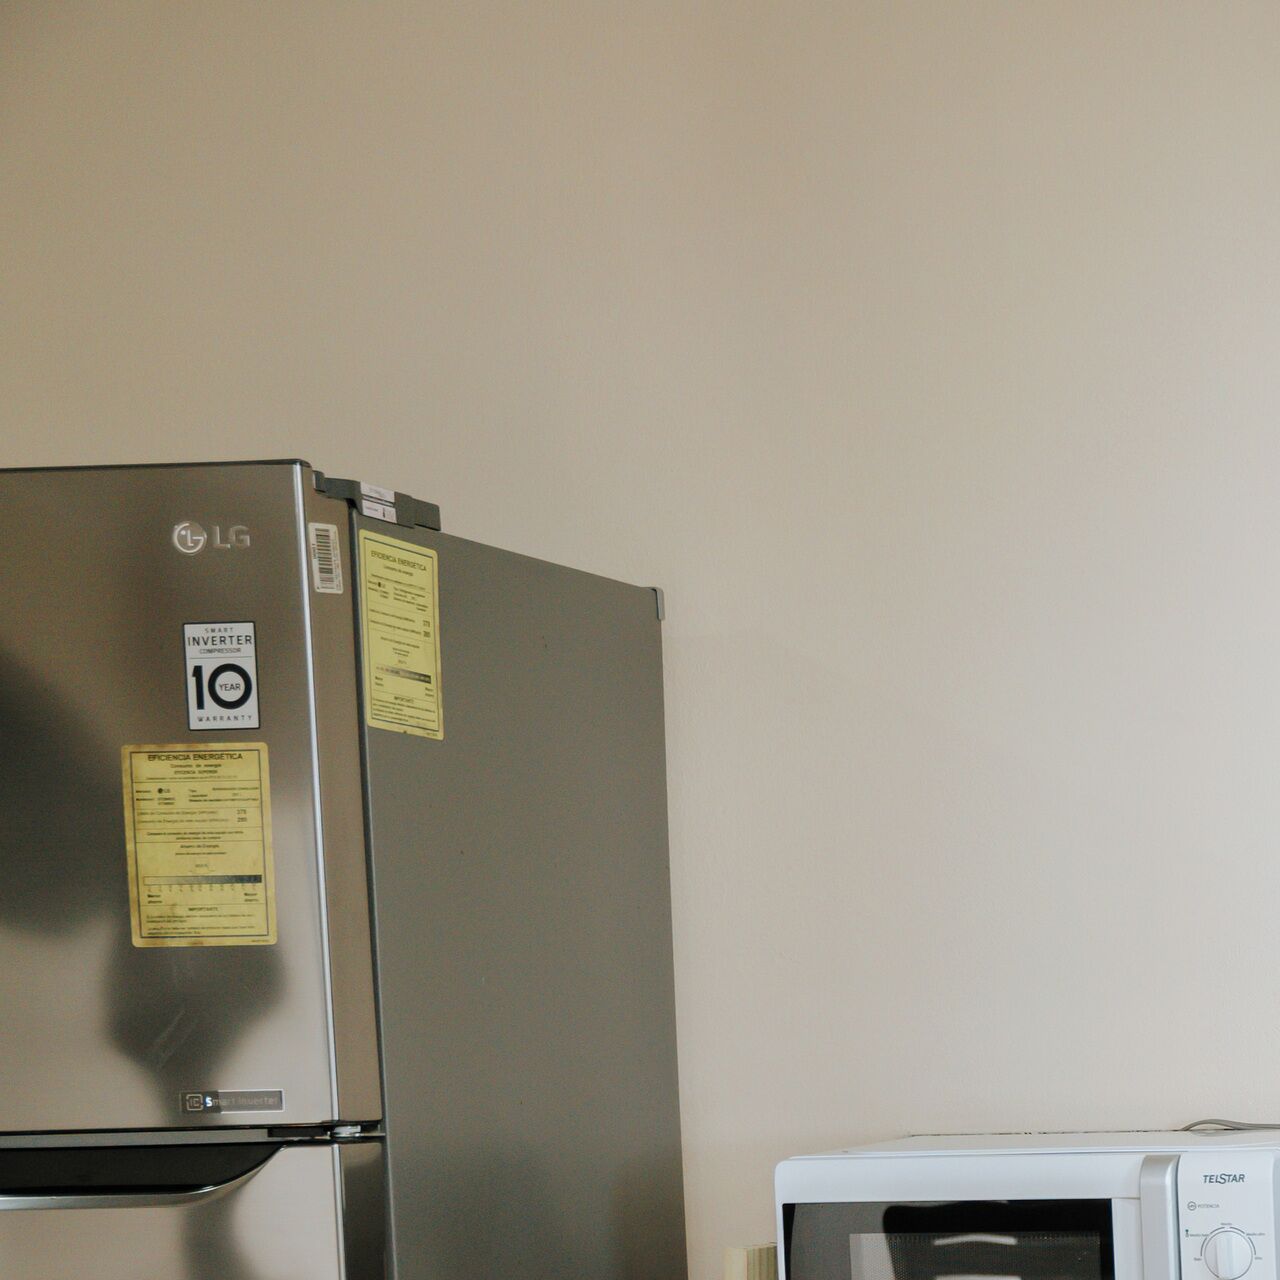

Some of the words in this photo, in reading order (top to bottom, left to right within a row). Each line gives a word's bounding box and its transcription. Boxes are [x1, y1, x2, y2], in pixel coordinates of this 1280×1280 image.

[213, 525, 250, 548] LG
[187, 635, 253, 647] INVERTER
[192, 663, 253, 710] 10
[219, 683, 241, 691] YEAR
[1203, 1173, 1246, 1184] TELSTAR
